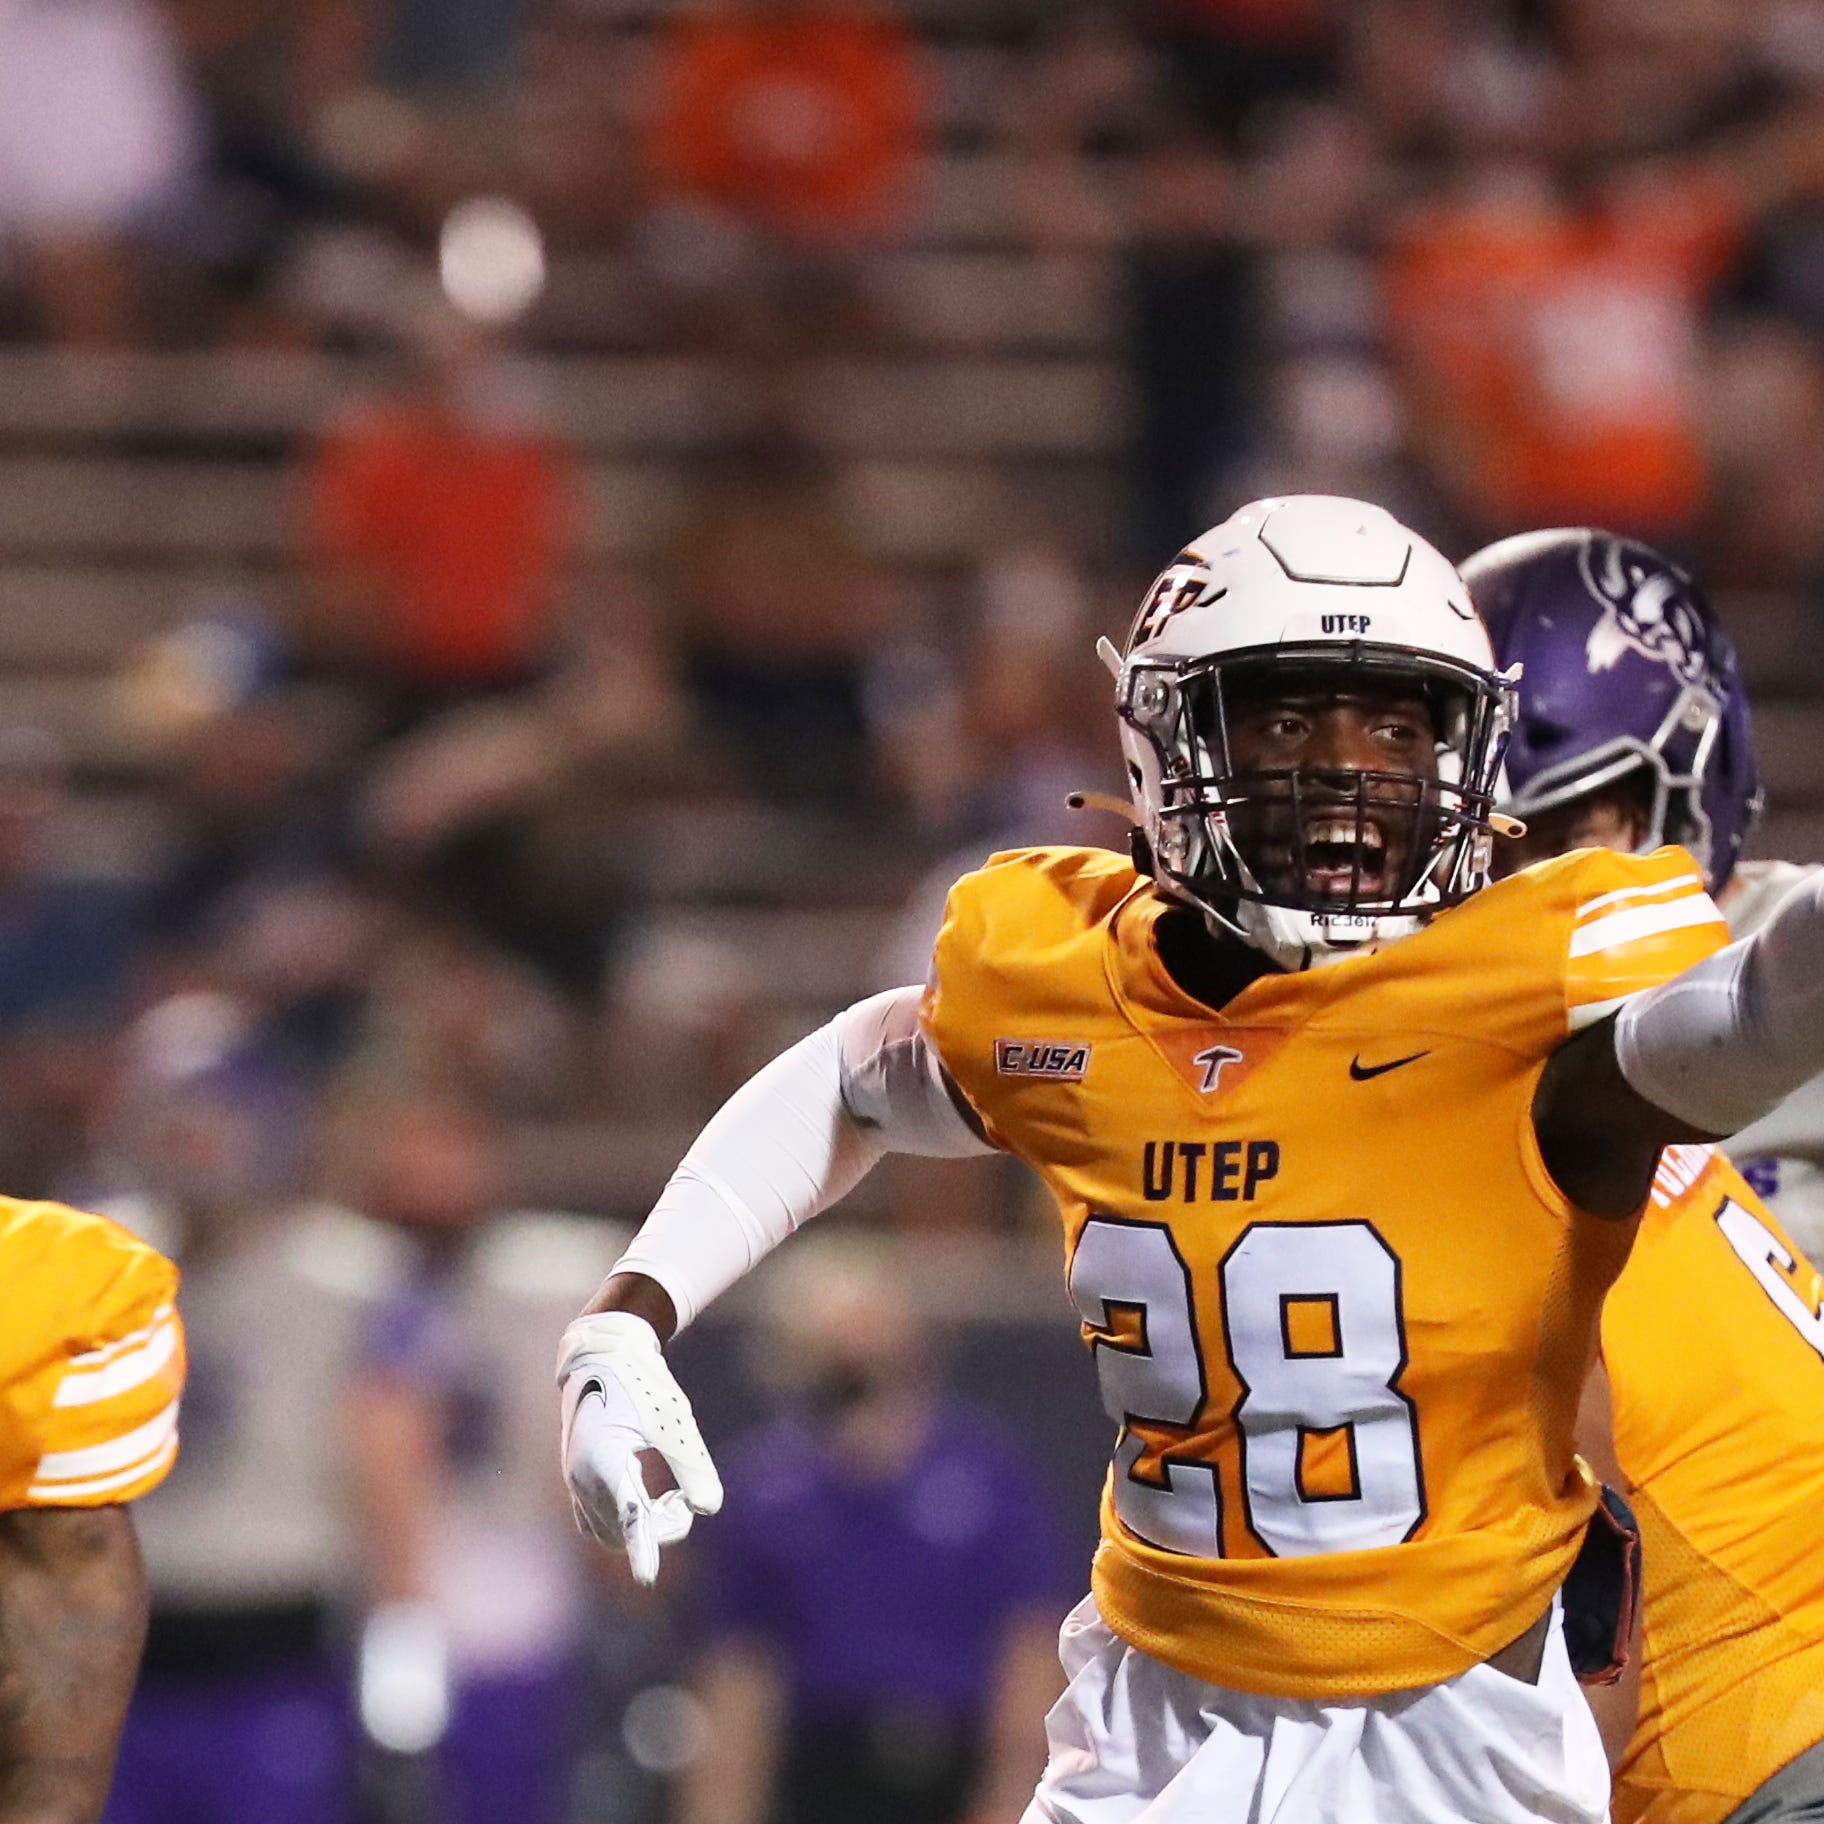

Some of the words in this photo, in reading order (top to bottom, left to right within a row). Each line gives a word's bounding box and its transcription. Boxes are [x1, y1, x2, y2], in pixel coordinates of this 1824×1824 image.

[1320, 613, 1371, 635] UTEP
[1142, 1140, 1280, 1202] UTEP
[1066, 1212, 1427, 1559] 28
